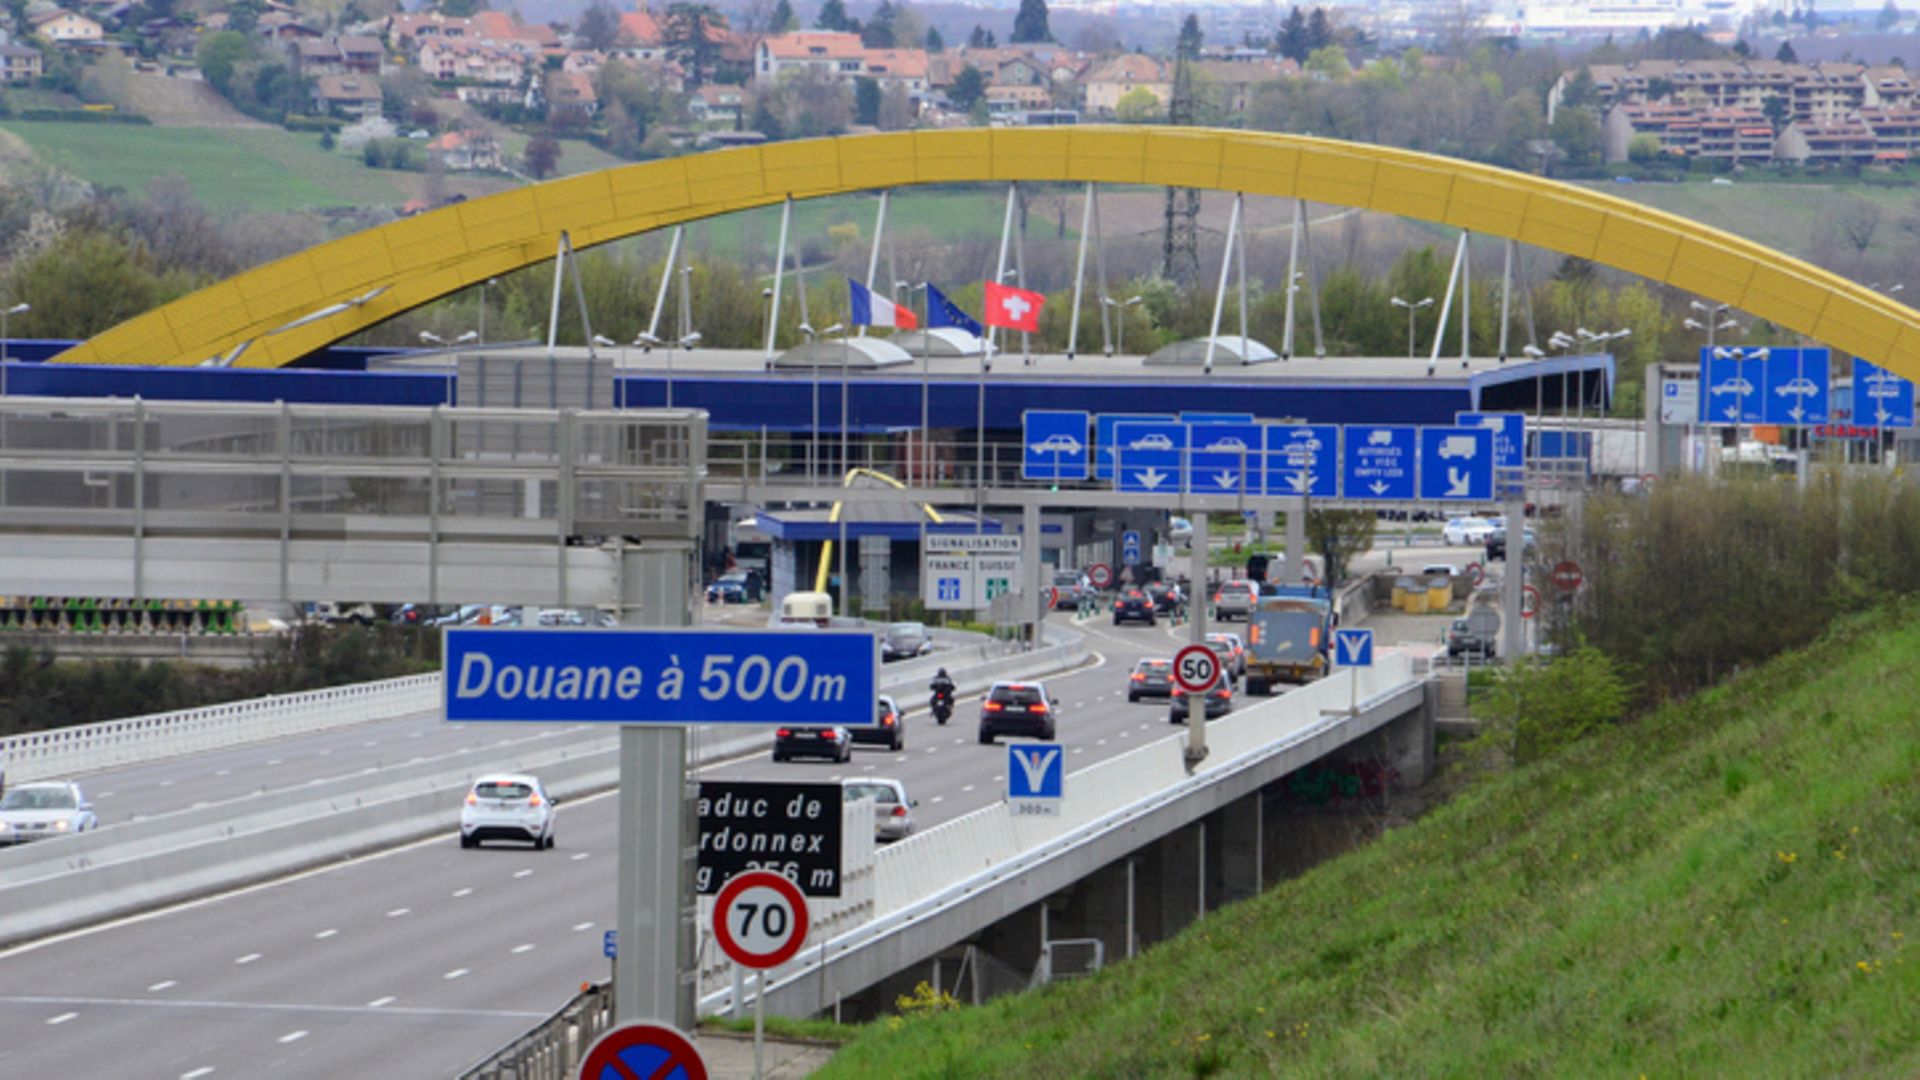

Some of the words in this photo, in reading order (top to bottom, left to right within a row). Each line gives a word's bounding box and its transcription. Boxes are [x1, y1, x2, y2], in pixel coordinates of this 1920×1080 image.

[929, 539, 1018, 548] SIGNALISATION
[929, 561, 969, 570] FRANCE
[979, 561, 1016, 570] SUISSE
[457, 652, 643, 701] Douane
[656, 655, 685, 701] à
[1183, 659, 1212, 680] 50
[785, 794, 822, 818] de
[810, 868, 835, 888] m
[736, 903, 788, 939] 70
